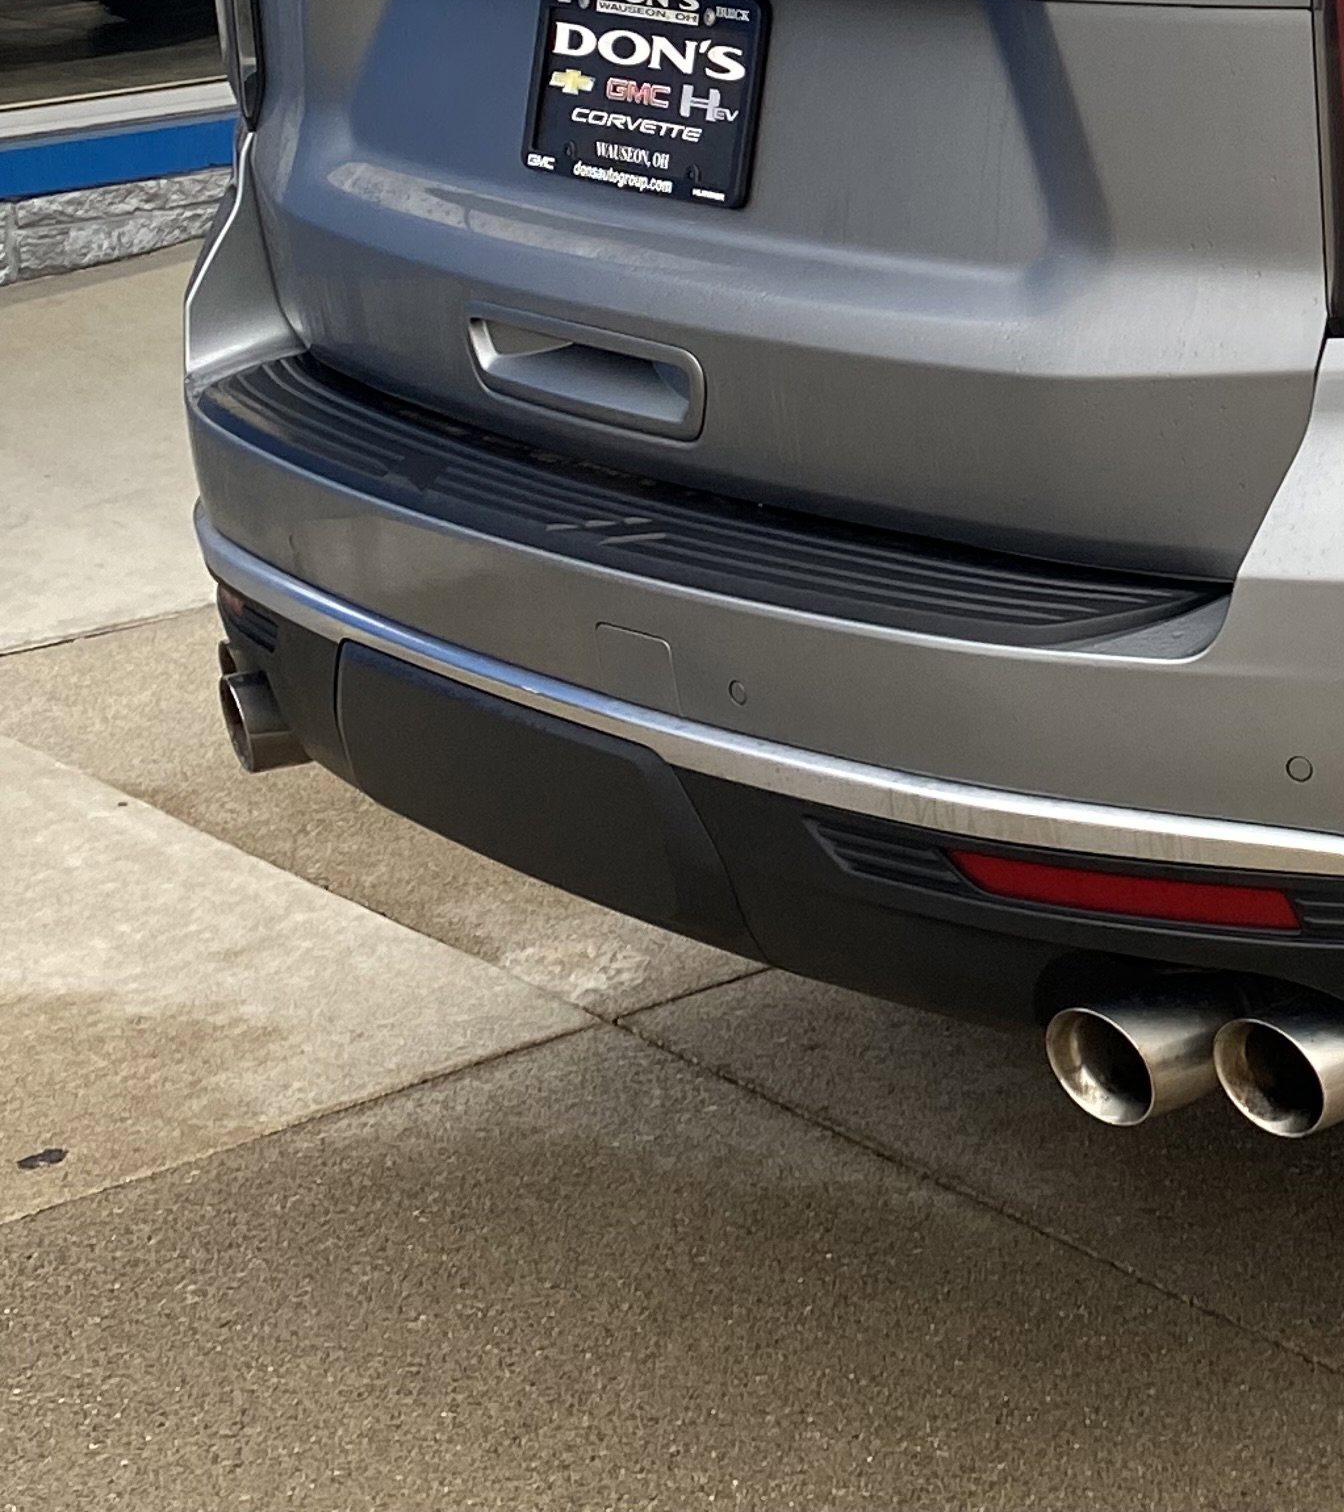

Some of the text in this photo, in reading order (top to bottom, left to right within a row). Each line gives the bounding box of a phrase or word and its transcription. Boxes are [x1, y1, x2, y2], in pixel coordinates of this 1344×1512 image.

[674, 12, 699, 23] OH
[715, 6, 750, 22] BUICK
[552, 21, 746, 81] DON'S
[606, 77, 671, 109] GMC
[571, 107, 703, 143] CORVETTE
[527, 153, 556, 170] GMC
[596, 141, 670, 170] WAUSEON, OH
[573, 160, 673, 193] donsautogroup.com
